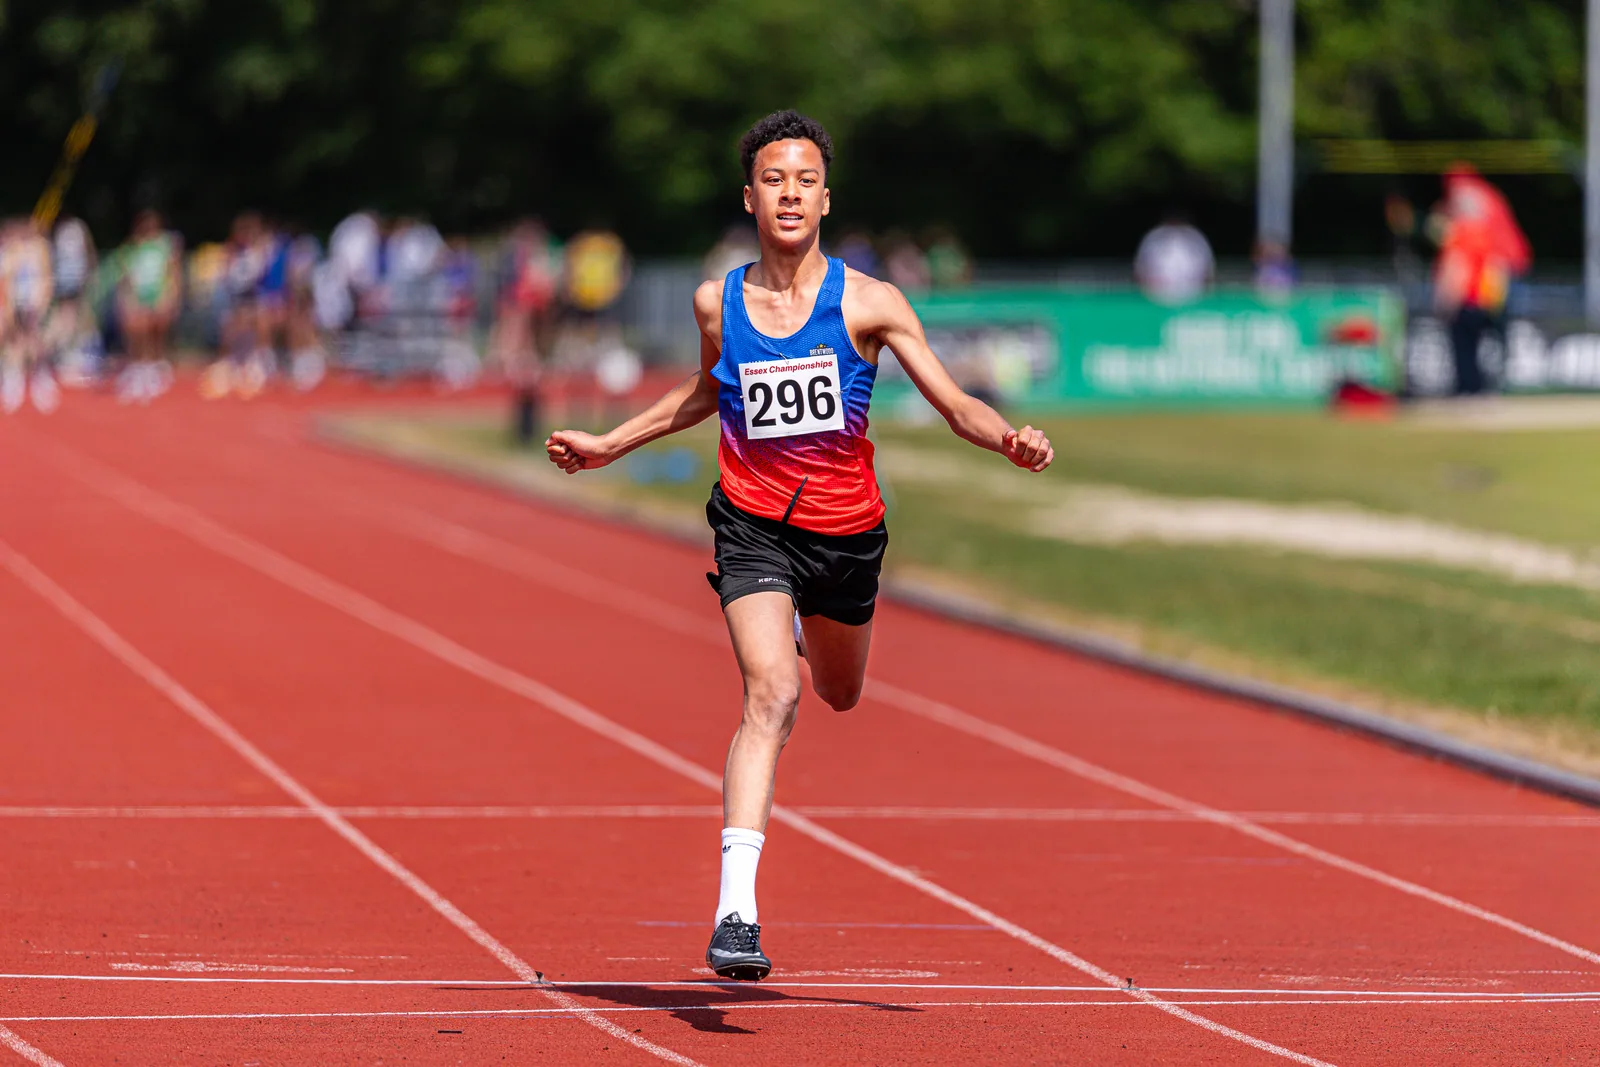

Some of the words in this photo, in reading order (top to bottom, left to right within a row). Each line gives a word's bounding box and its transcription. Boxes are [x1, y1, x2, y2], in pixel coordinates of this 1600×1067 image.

[744, 367, 768, 376] Essex
[769, 360, 833, 374] Championships
[748, 375, 836, 428] 296
